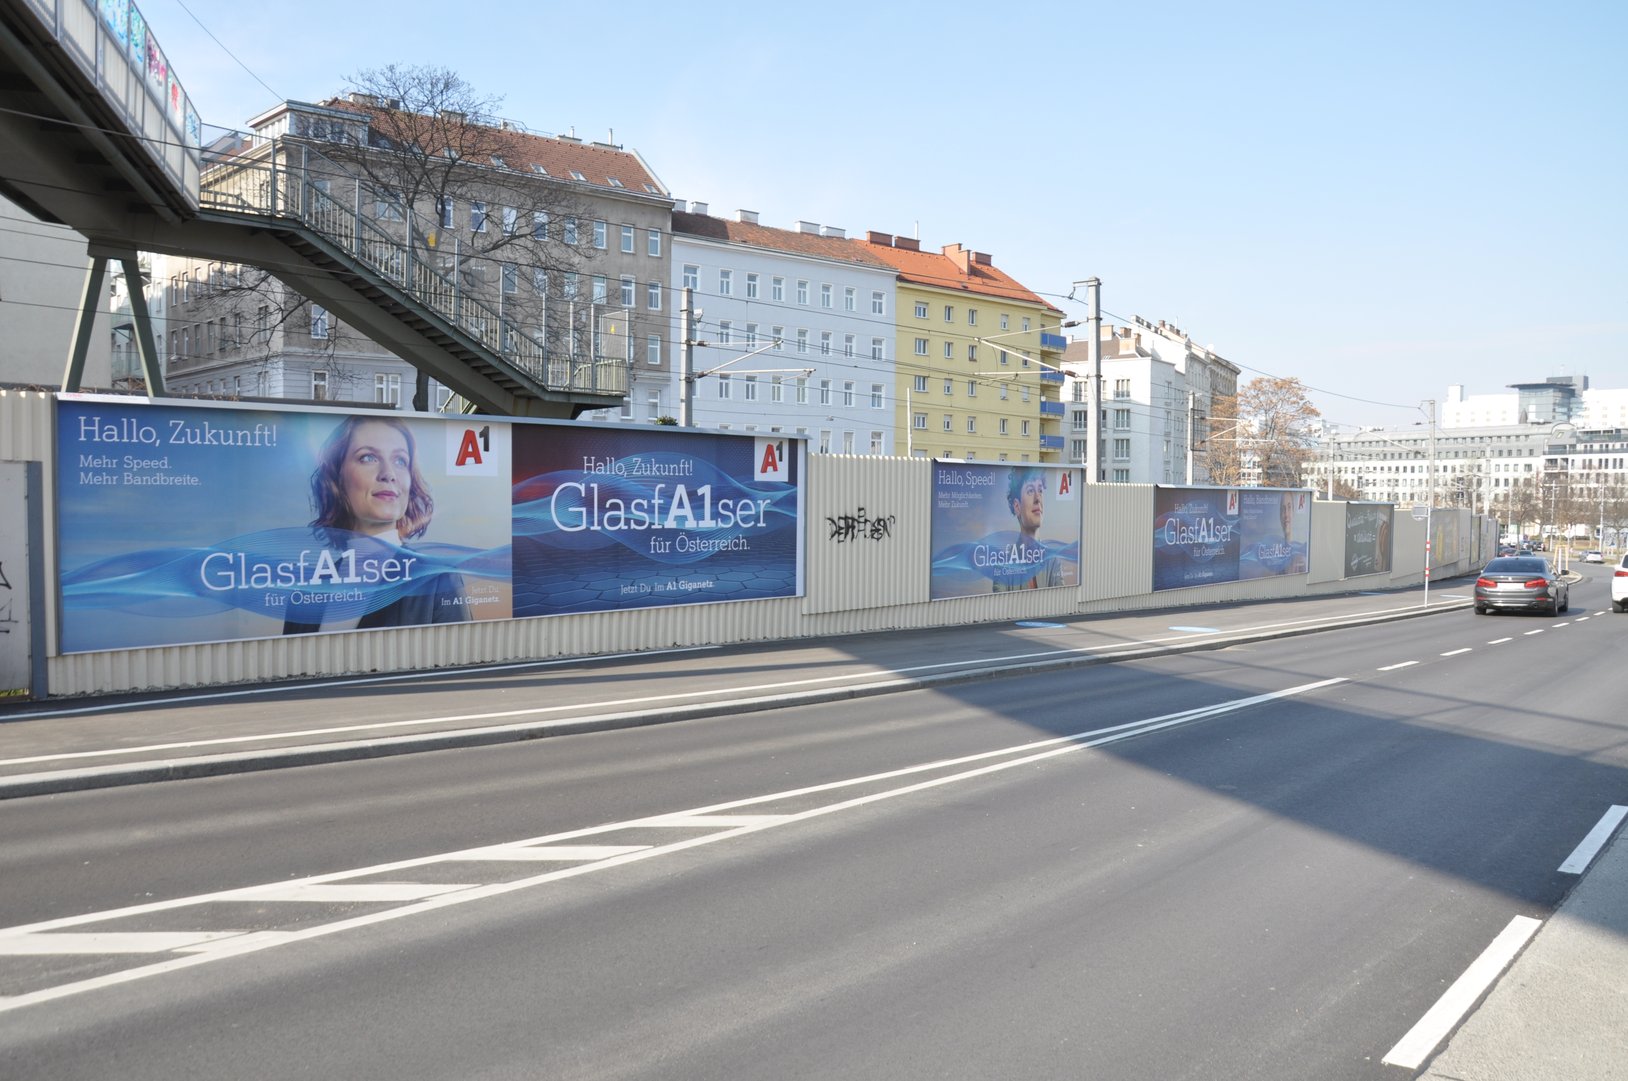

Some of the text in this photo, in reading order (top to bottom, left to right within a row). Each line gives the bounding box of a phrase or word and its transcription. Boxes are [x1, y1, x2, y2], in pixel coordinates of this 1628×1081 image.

[78, 416, 277, 447] Hallo, Zukunft!
[455, 425, 490, 467] A1
[760, 440, 783, 474] A1
[79, 455, 172, 471] Mehr Speed.
[583, 456, 693, 477] Hallo, Zukunft!
[79, 472, 202, 486] Mehr Bandbreite.
[938, 470, 996, 488] Hallo, Speed!
[1059, 470, 1072, 495] A1
[550, 481, 771, 532] GlasfA1ser
[1164, 517, 1233, 545] GlasfA1ser
[650, 532, 750, 553] für Österreich.
[973, 543, 1046, 567] GlasfA1ser
[200, 548, 417, 591] GlasfA1ser
[265, 588, 366, 606] für Österreich.
[620, 584, 638, 595] Jetzt
[666, 581, 677, 591] A1
[441, 597, 451, 606] Im
[453, 596, 463, 605] A1
